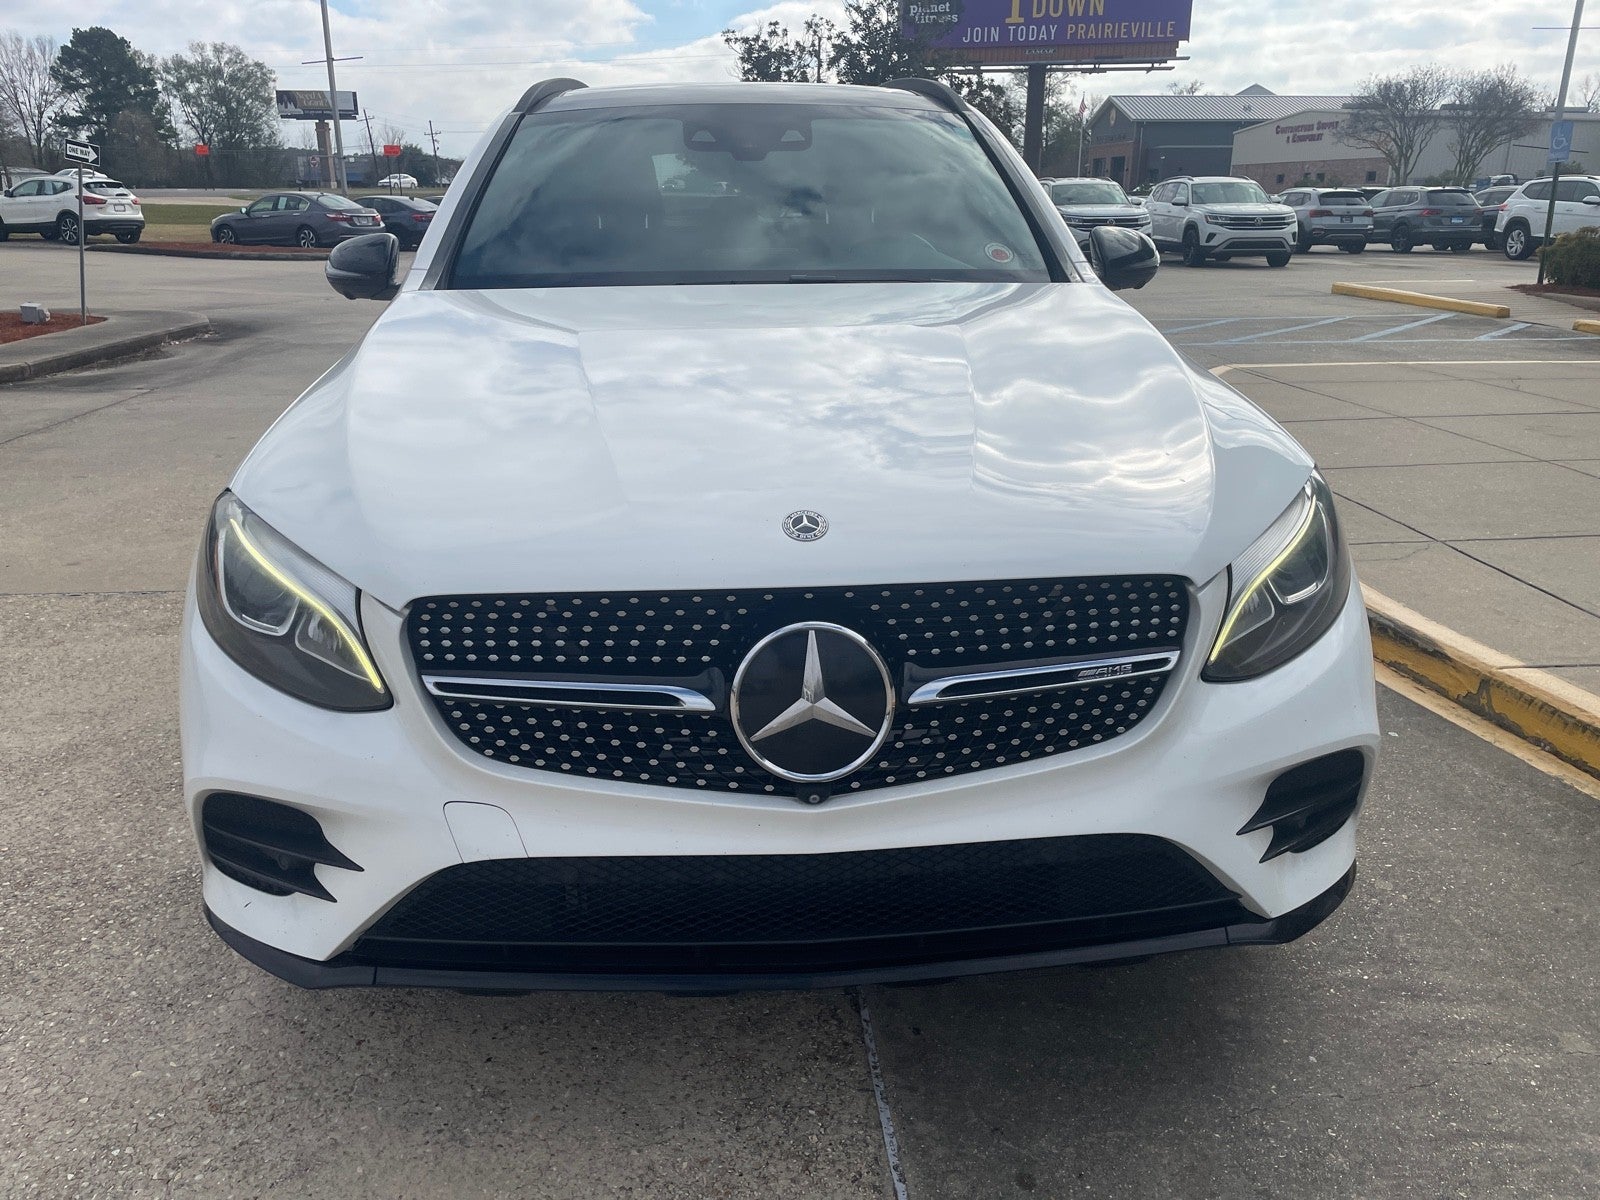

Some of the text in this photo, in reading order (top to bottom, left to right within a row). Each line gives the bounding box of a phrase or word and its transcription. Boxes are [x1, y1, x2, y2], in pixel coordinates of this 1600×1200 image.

[1032, 0, 1105, 18] DOWN
[962, 21, 1176, 43] JOIN TODAY PRAIRIEVILLE
[68, 146, 90, 157] ONE WAY
[1095, 664, 1132, 675] AMG
